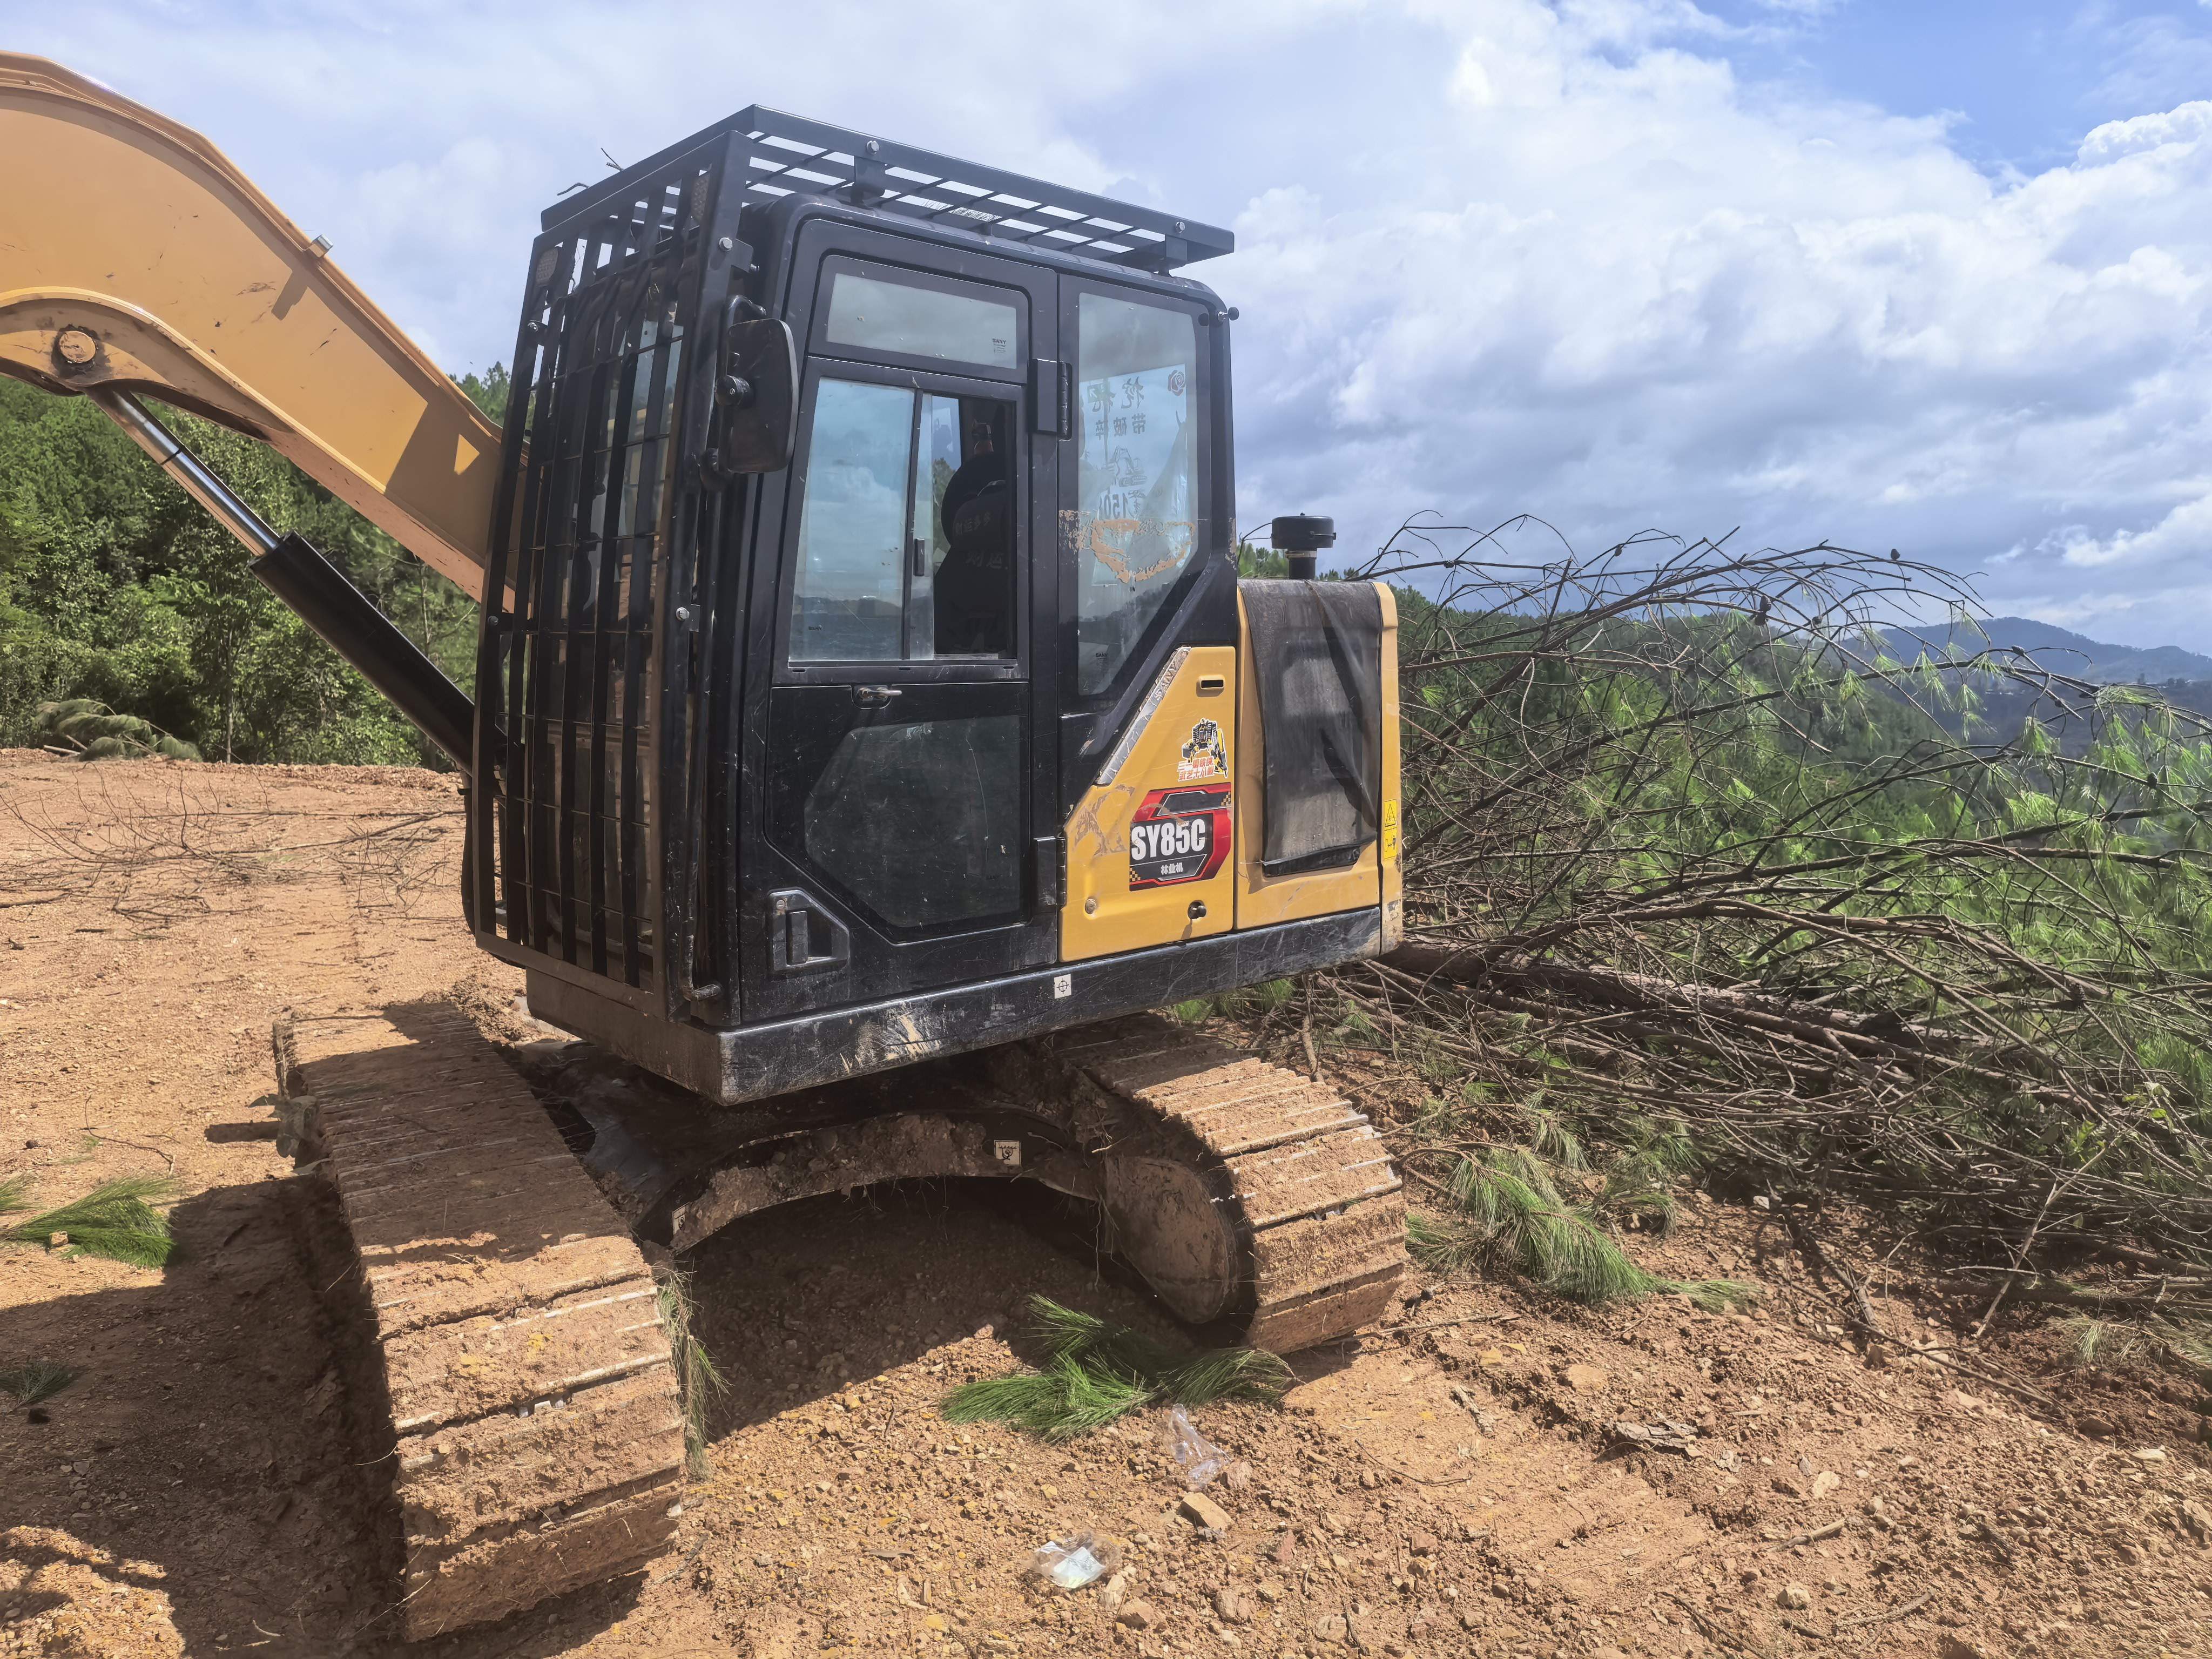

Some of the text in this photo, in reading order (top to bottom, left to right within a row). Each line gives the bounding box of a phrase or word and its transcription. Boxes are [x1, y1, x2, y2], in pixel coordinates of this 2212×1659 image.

[1131, 819, 1205, 860] SY85C
[1161, 862, 1183, 875] 林业机
